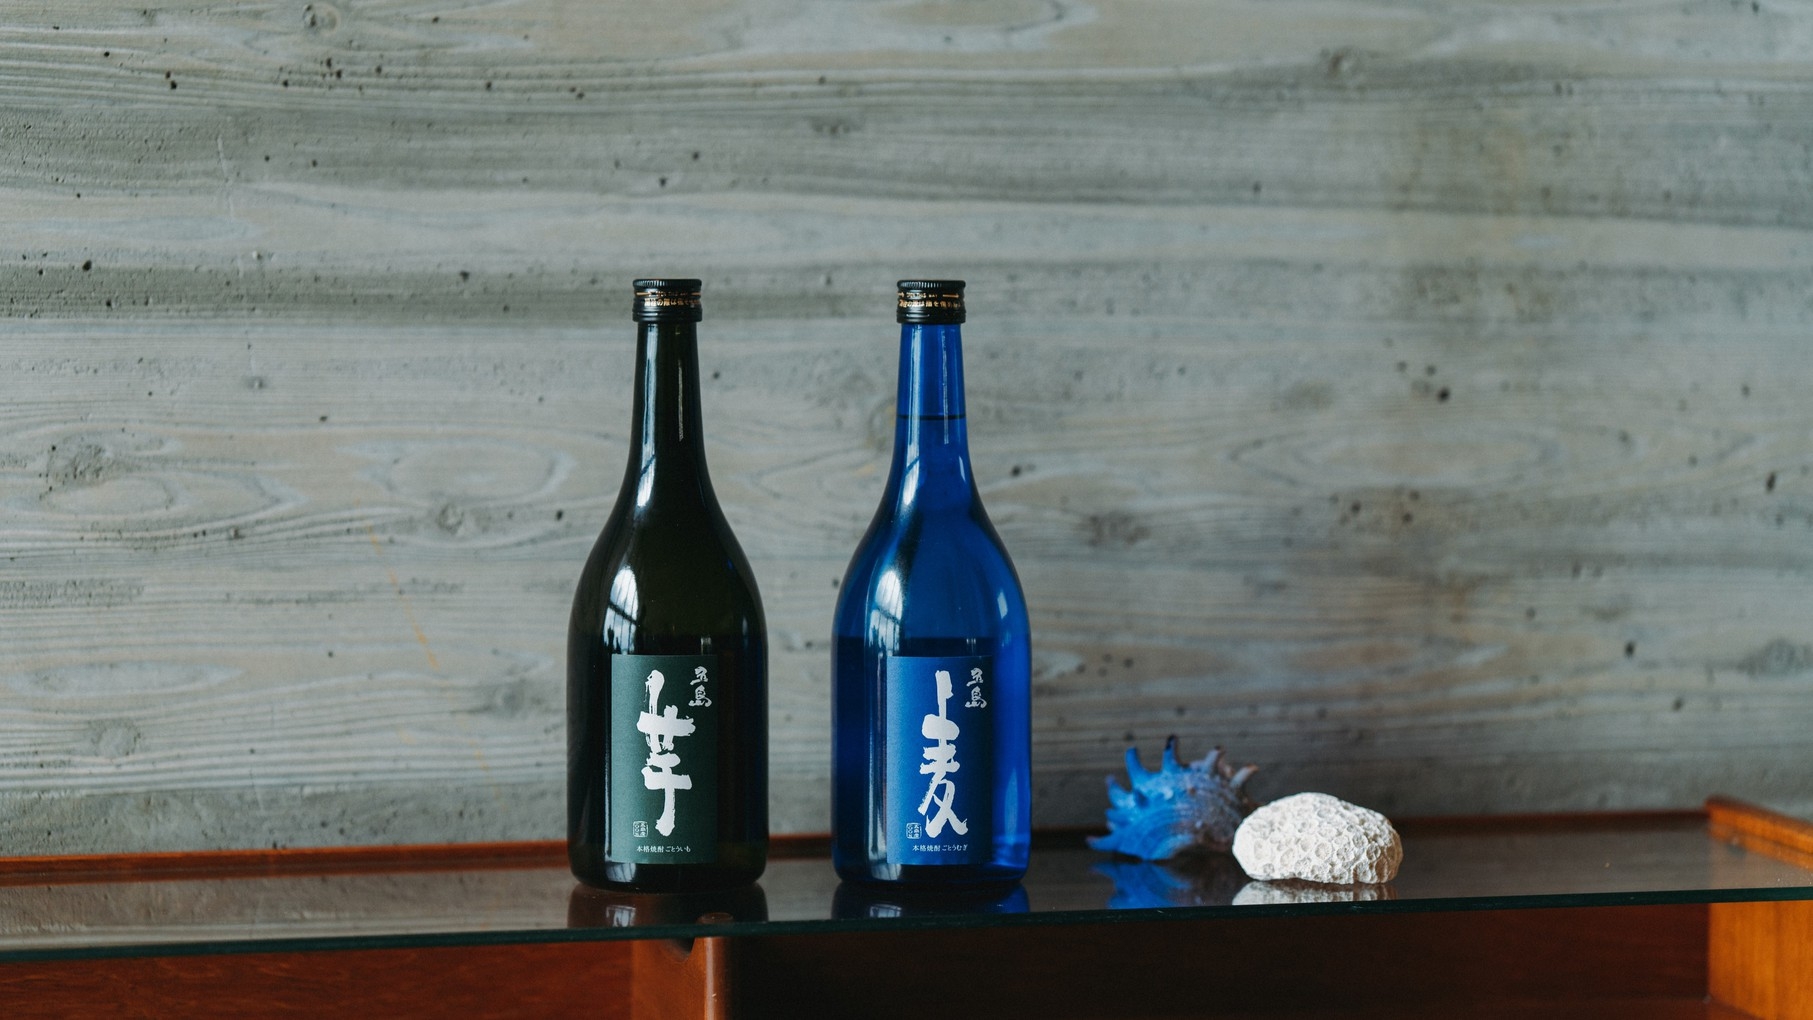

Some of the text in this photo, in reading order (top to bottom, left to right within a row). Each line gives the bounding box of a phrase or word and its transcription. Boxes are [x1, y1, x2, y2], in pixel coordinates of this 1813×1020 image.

[636, 669, 696, 837] 芋
[918, 670, 969, 838] 麦
[636, 845, 665, 853] 本格焼酎
[912, 844, 968, 852] 本格焼酎 ごとうむぎ
